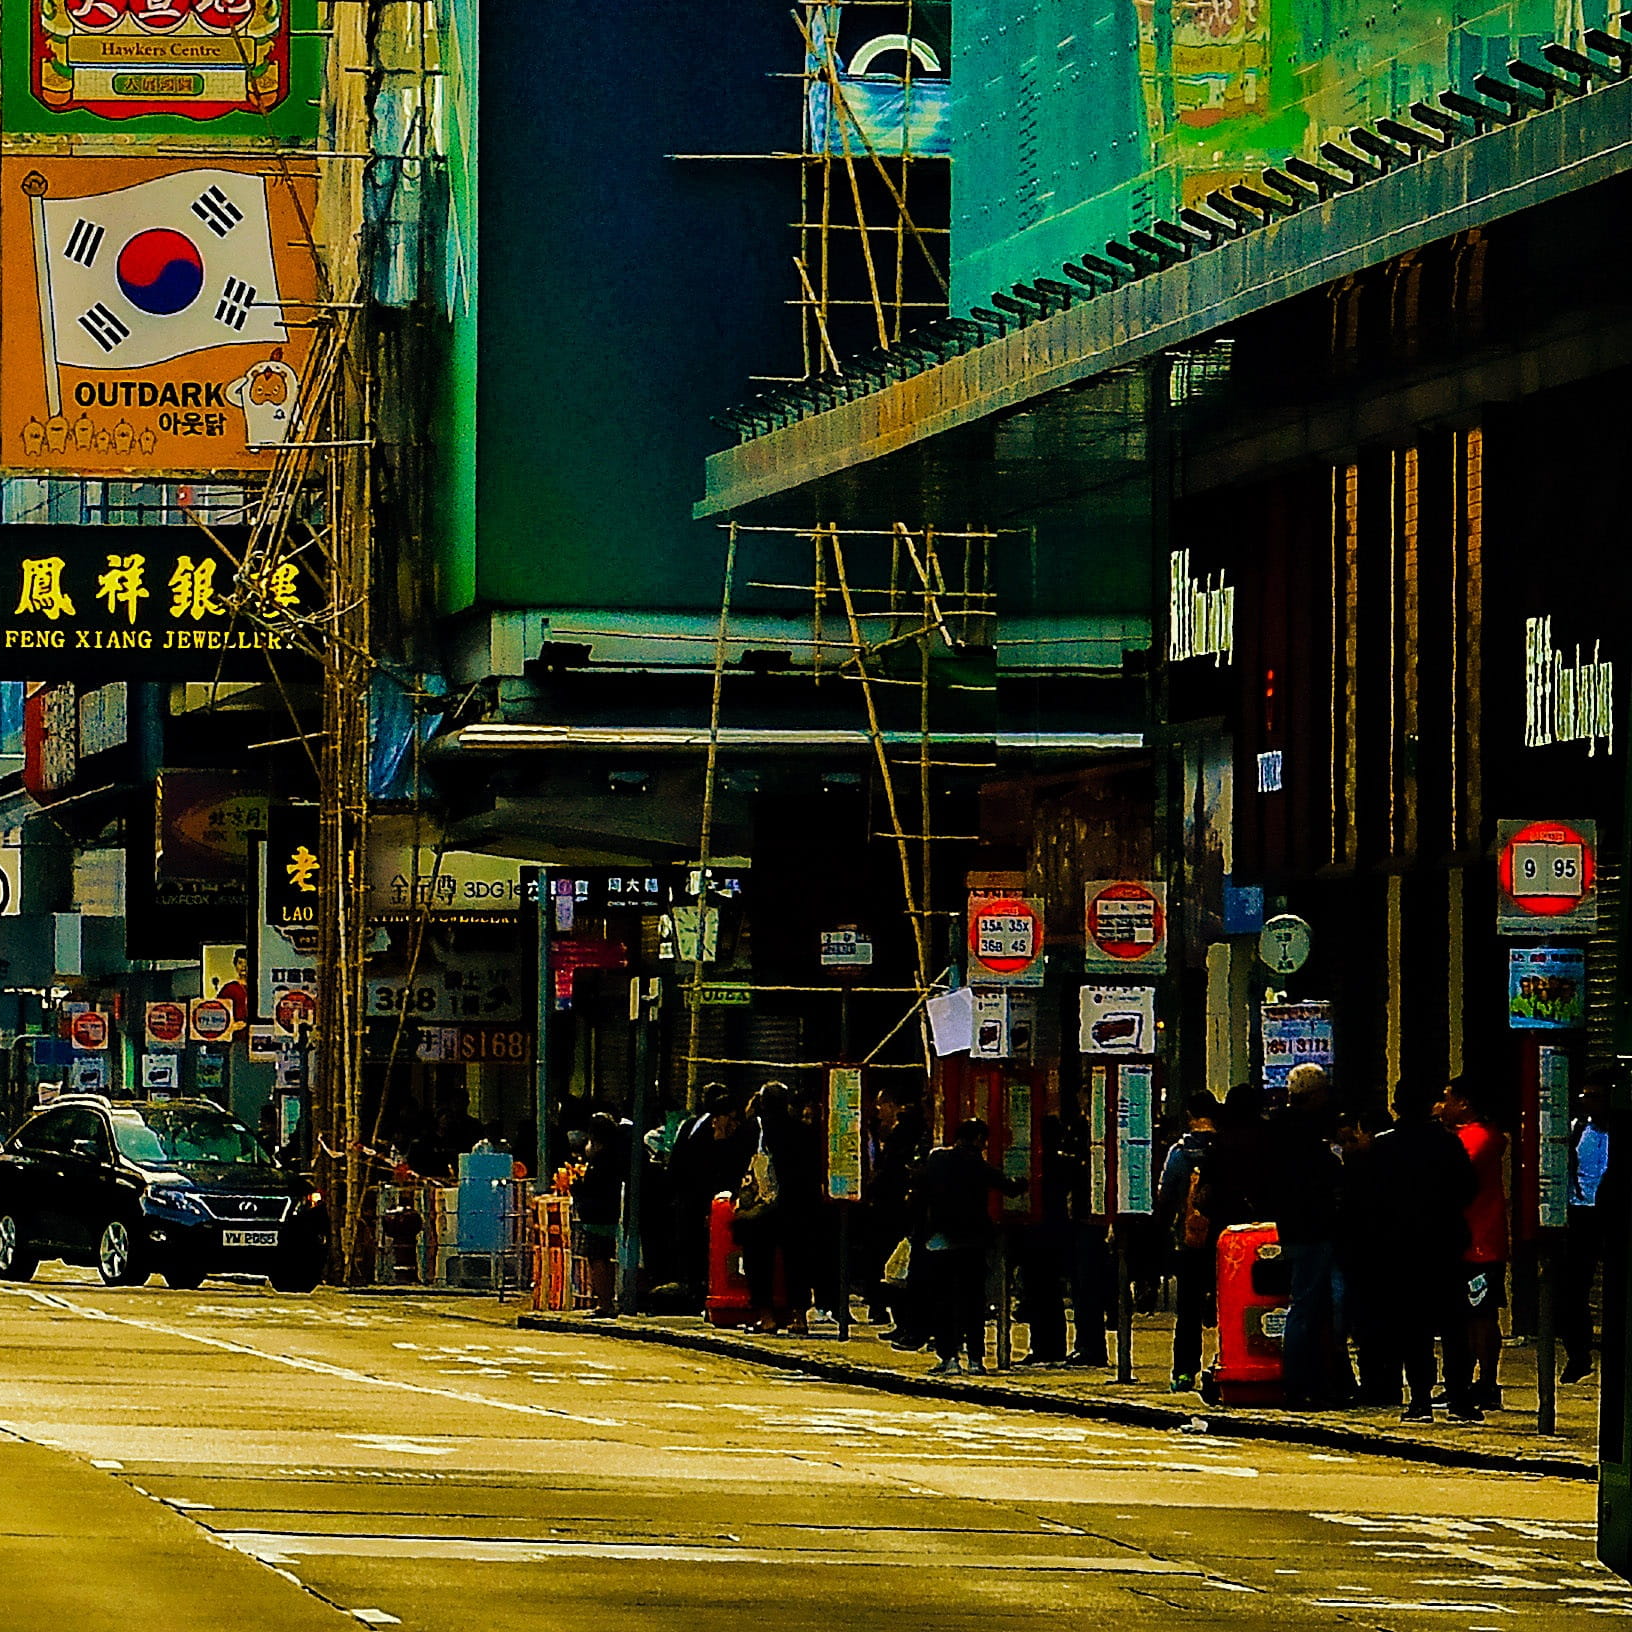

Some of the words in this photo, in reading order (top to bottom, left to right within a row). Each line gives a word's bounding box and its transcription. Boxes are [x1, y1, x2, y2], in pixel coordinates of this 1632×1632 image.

[101, 42, 166, 57] Hawkers
[170, 42, 222, 57] Centre
[74, 381, 226, 408] OUTDARK
[158, 412, 227, 437] 아웃닭
[5, 631, 65, 650] FENG
[75, 631, 153, 650] XIANG
[286, 845, 321, 892] 老
[1524, 859, 1536, 879] 9
[1553, 859, 1577, 879] 95
[463, 881, 505, 898] 3DG
[281, 906, 314, 922] LAO
